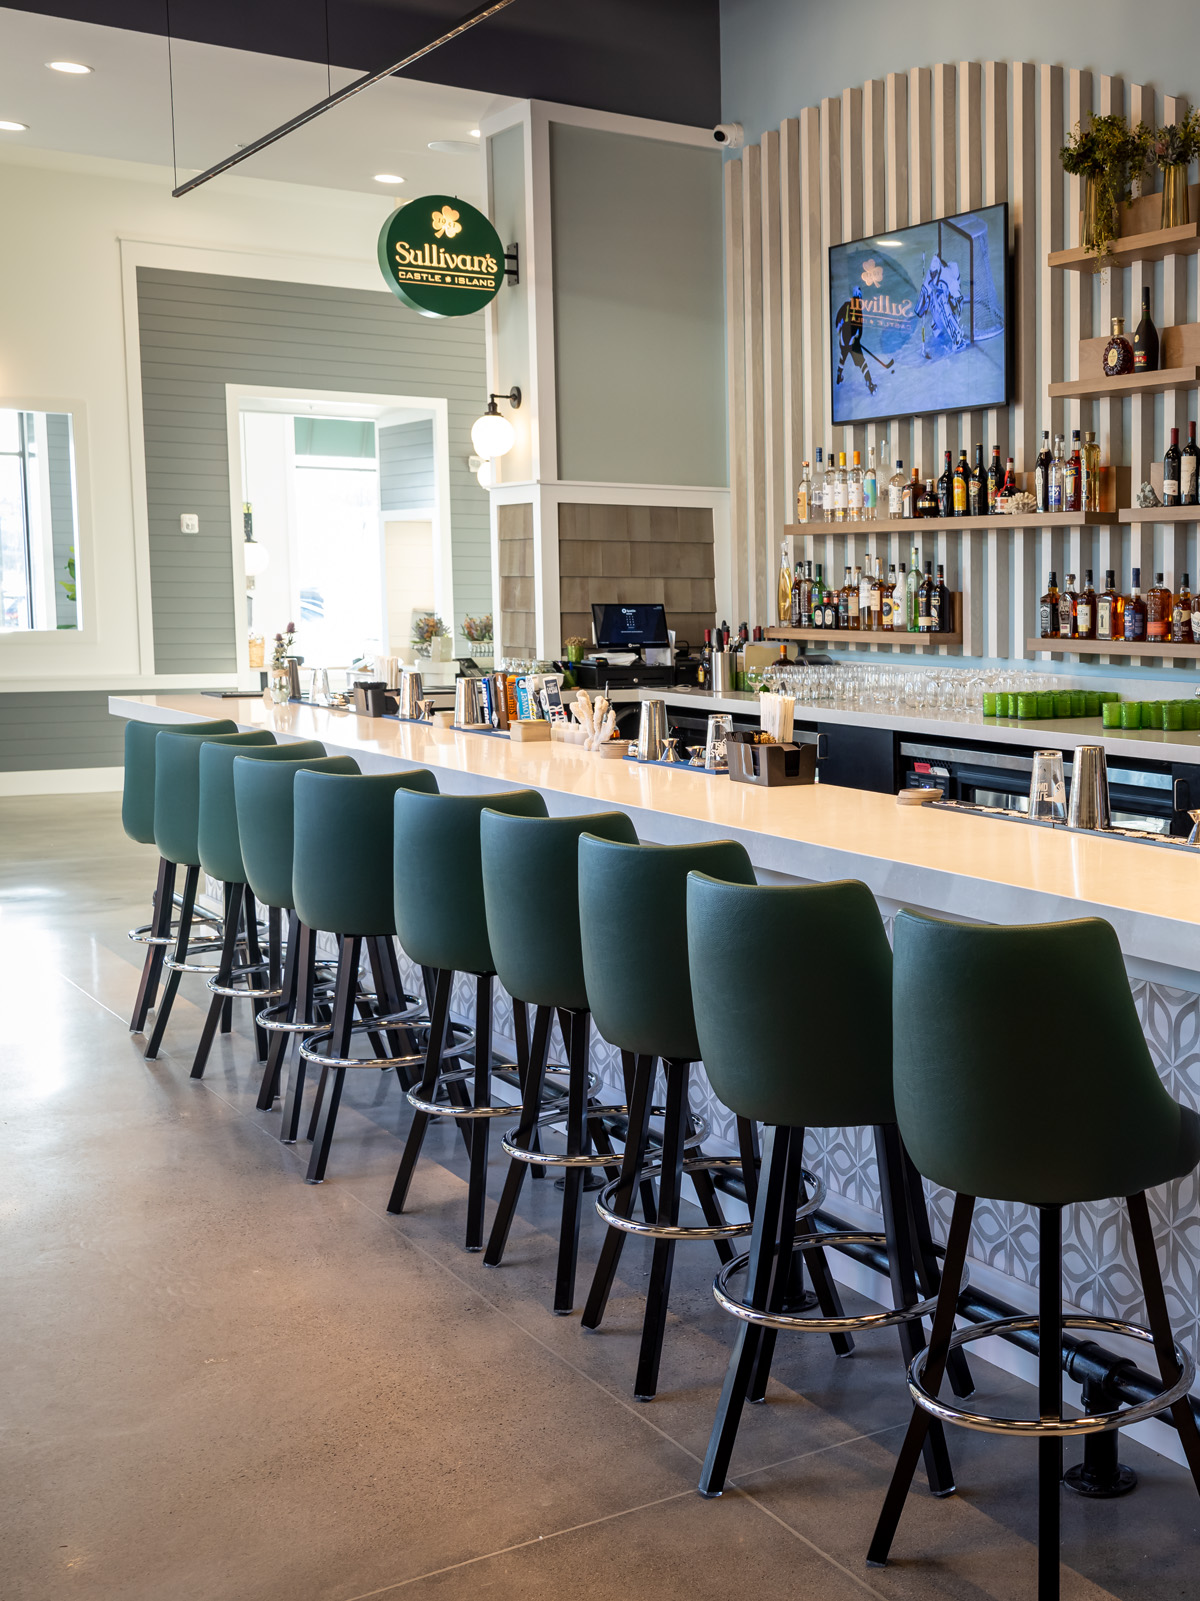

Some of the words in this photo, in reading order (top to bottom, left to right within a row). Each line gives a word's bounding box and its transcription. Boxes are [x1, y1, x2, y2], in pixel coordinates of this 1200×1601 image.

[395, 241, 498, 273] Sullivan's
[398, 271, 442, 283] CASTLE
[455, 276, 496, 288] ISLAND
[521, 691, 532, 720] flower
